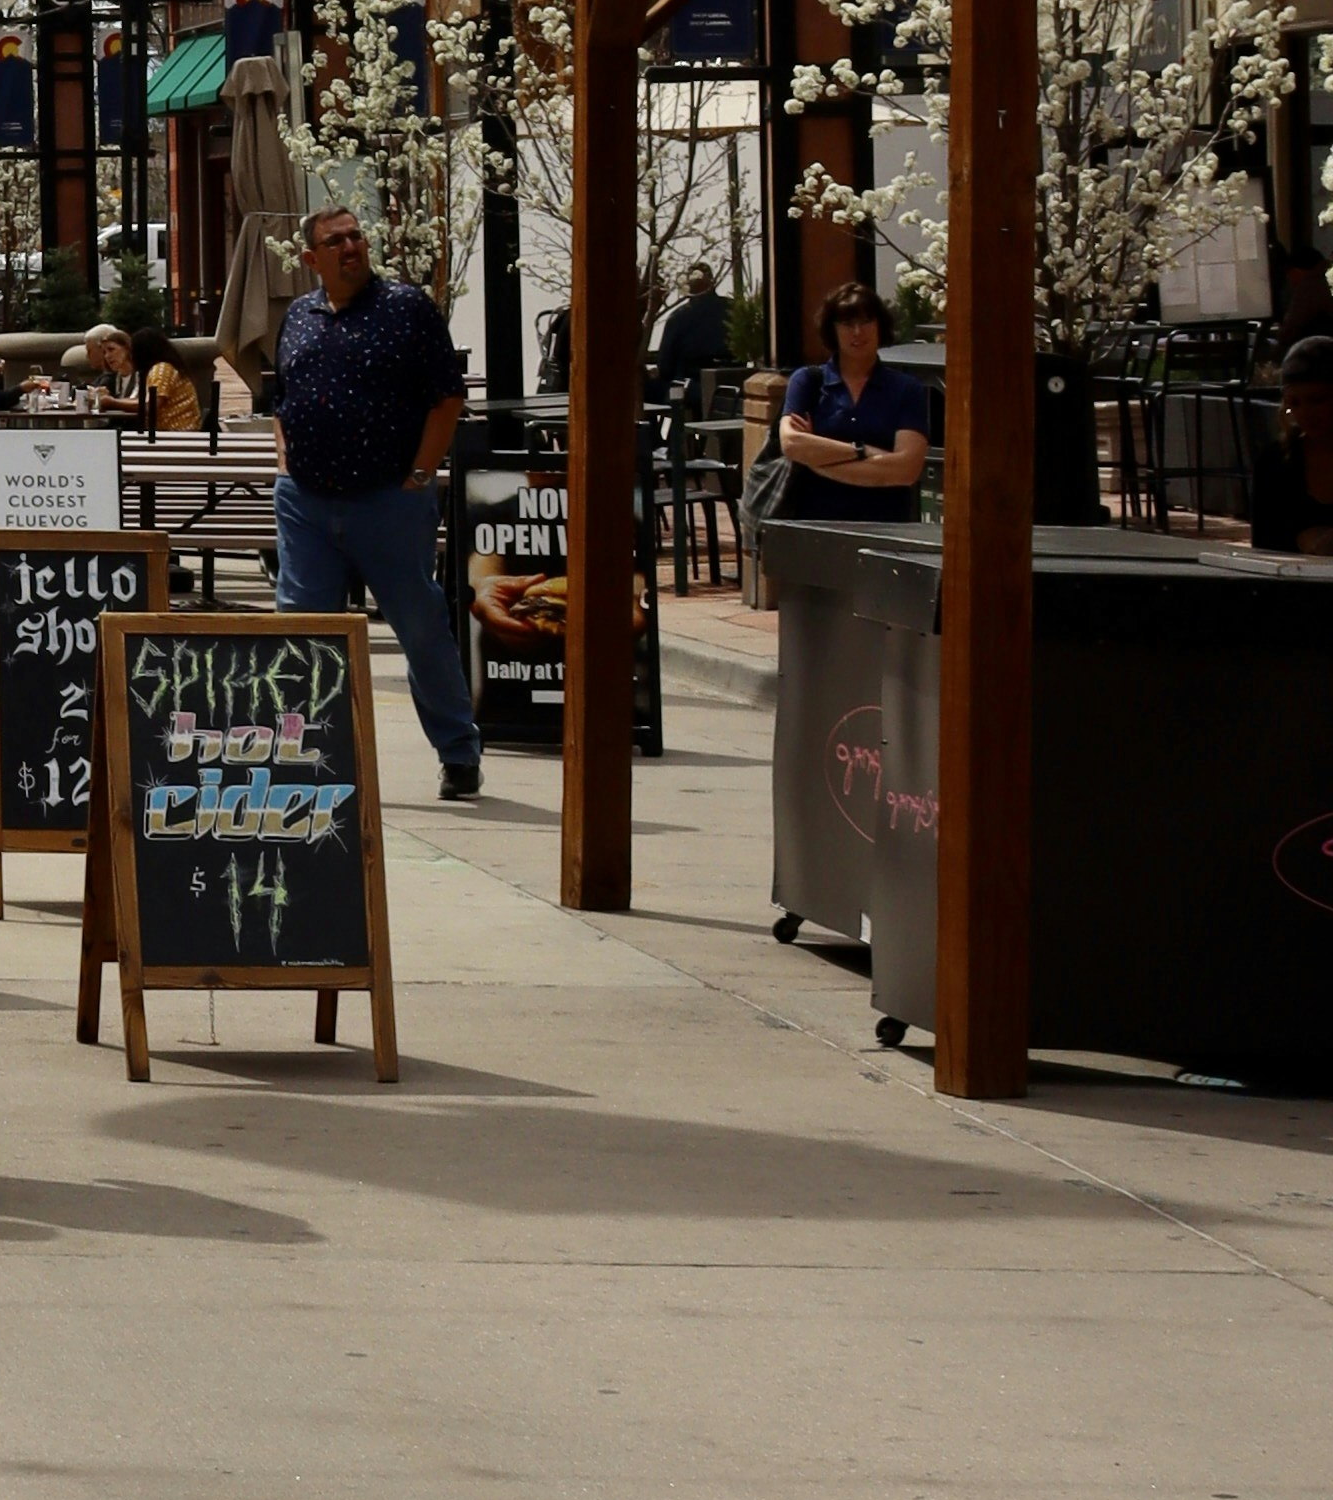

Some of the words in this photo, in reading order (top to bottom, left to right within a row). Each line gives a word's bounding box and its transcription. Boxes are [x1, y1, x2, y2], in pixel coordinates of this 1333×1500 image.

[5, 475, 85, 488] WORLD'S
[8, 494, 87, 508] CLOSEST
[5, 514, 88, 528] FLUEVOG
[475, 523, 551, 556] OPEN
[13, 553, 137, 605] jello
[130, 637, 346, 726] SPIKED
[486, 660, 531, 681] Daily
[534, 661, 553, 681] at
[59, 682, 90, 722] 2
[45, 726, 83, 755] for
[167, 711, 323, 765] hot
[144, 767, 357, 844] cider
